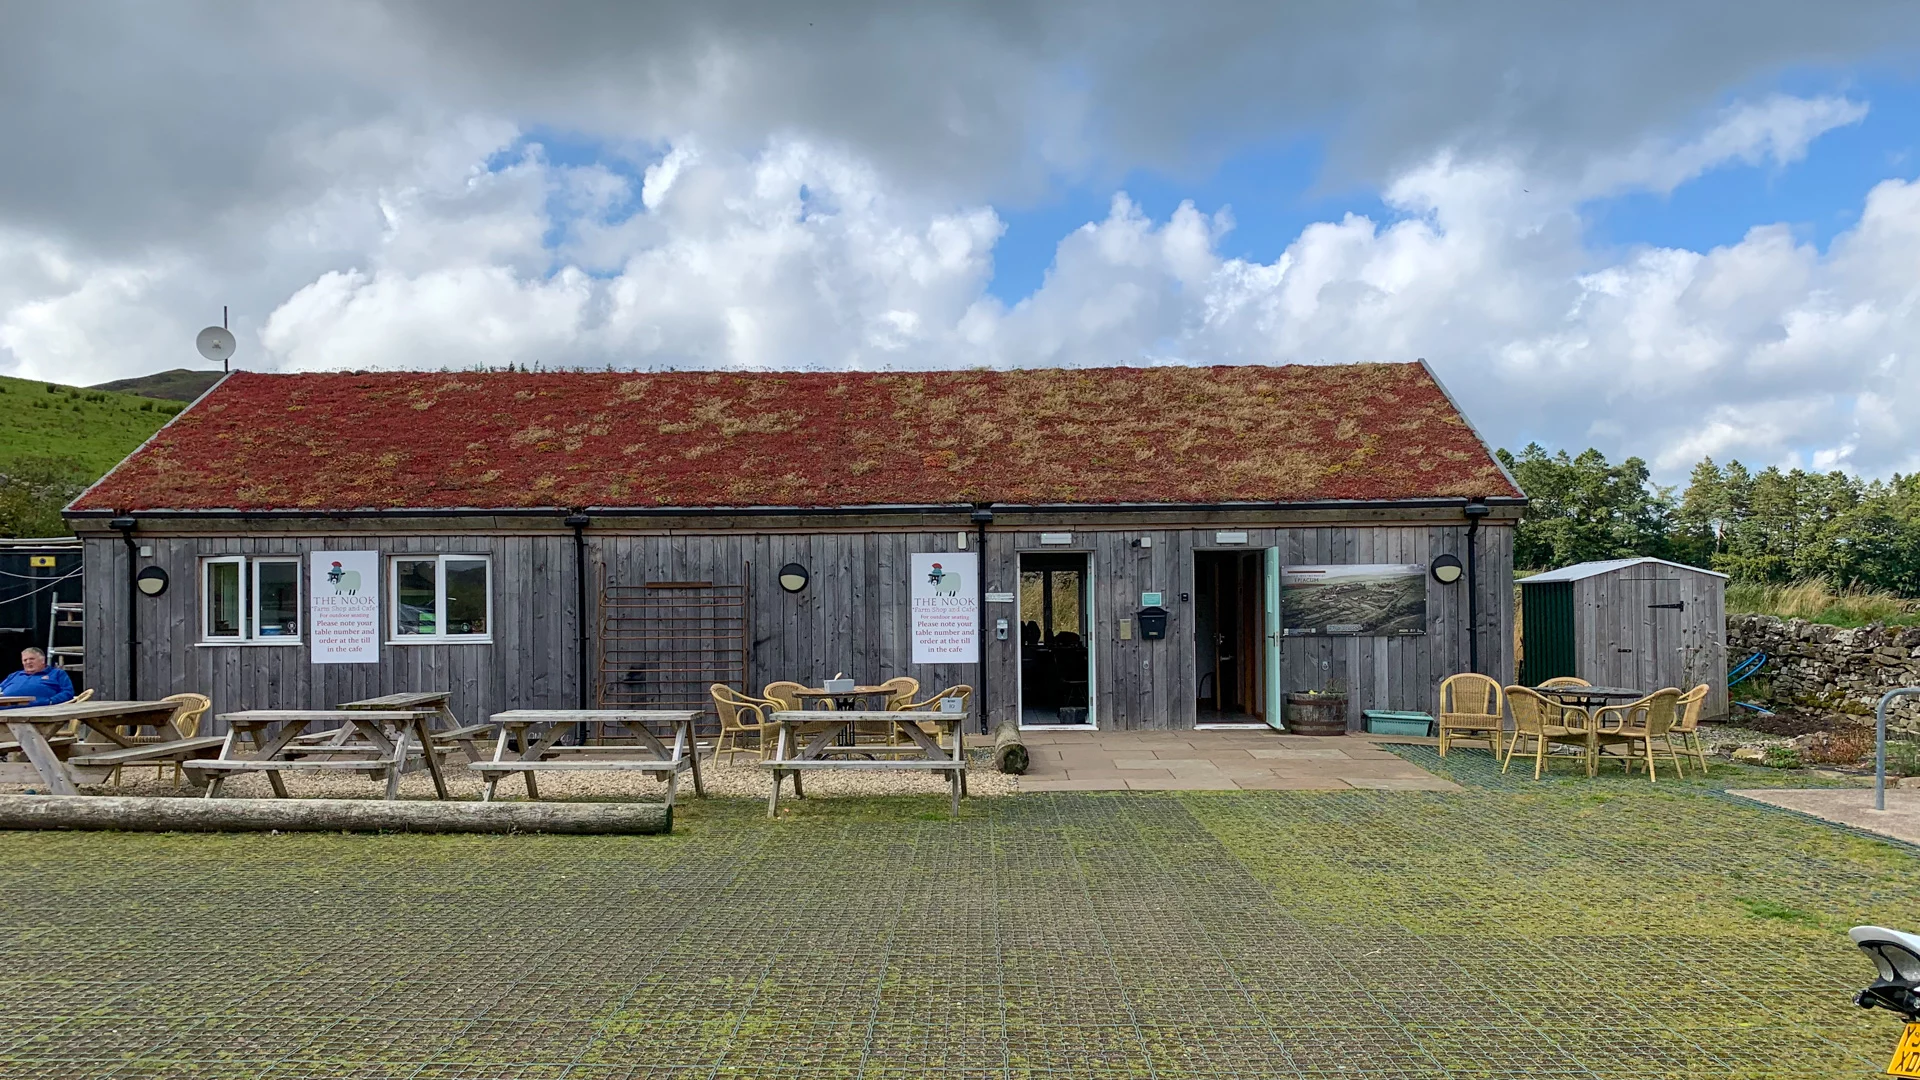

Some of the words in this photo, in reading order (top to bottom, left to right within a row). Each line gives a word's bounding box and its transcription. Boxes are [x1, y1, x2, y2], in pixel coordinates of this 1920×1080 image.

[313, 596, 336, 605] THE
[341, 596, 376, 605] NOOK
[914, 598, 936, 606] THE
[942, 598, 975, 606] NOOK
[1894, 1050, 1920, 1072] XD
